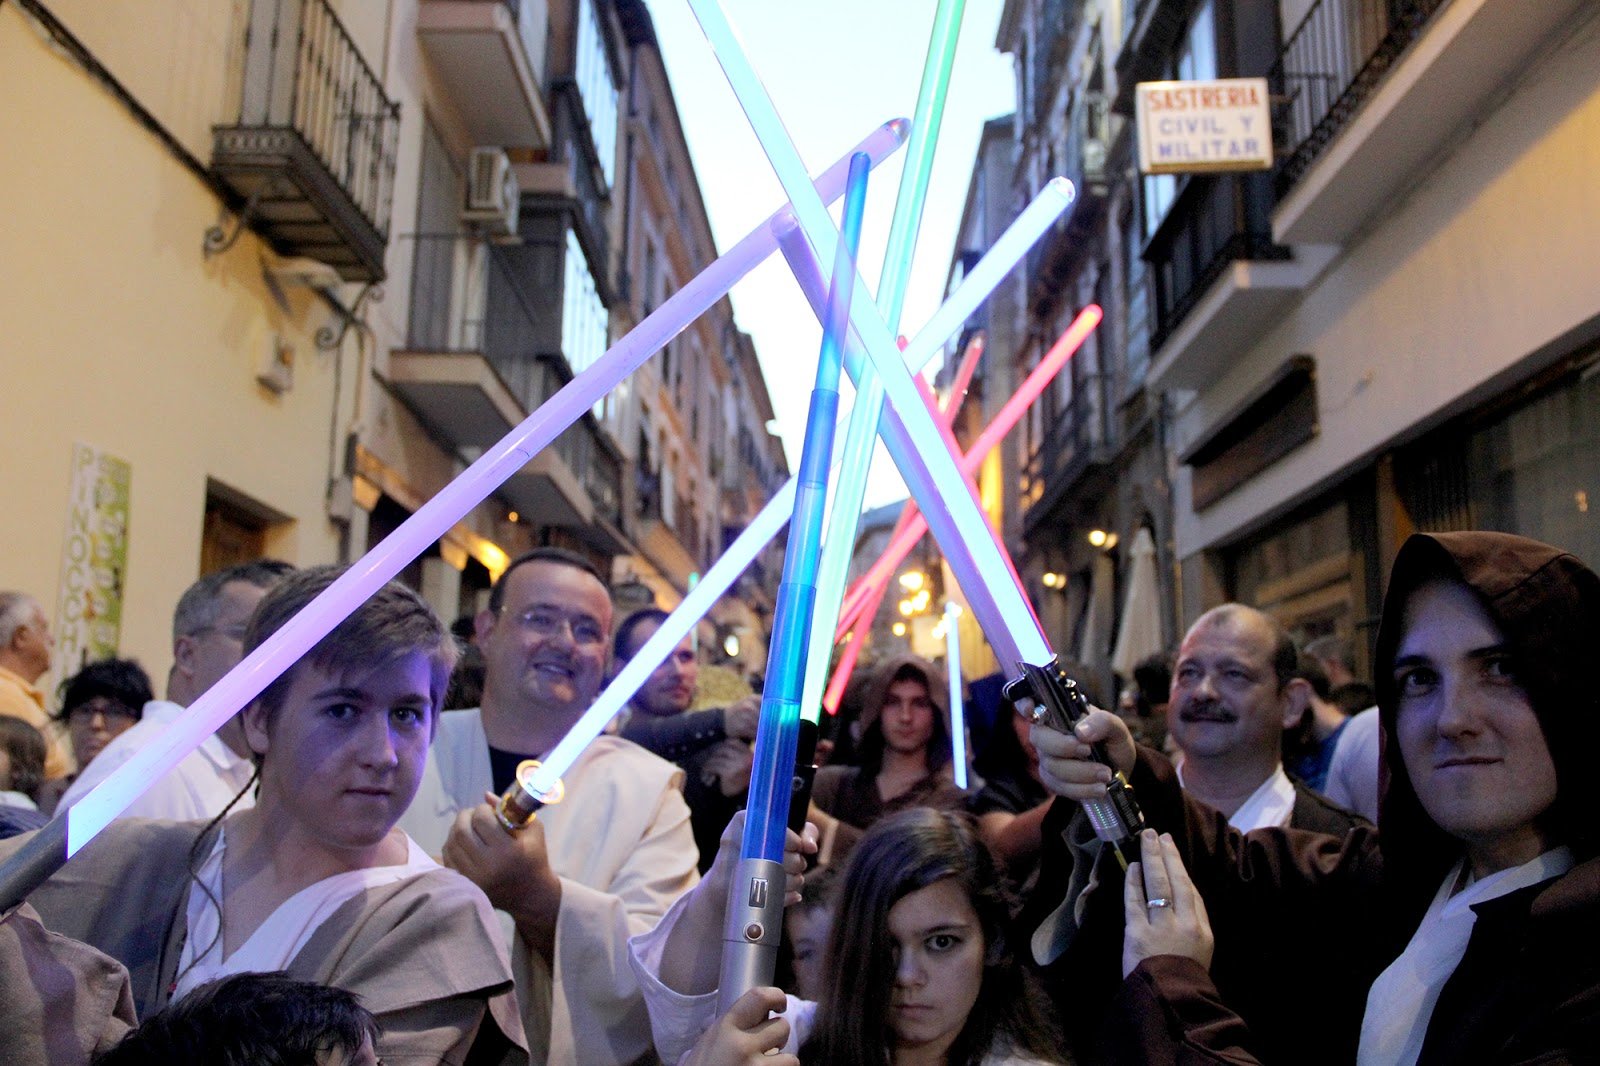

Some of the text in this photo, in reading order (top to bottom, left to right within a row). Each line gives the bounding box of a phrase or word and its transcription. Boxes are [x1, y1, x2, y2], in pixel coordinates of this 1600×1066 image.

[1159, 115, 1254, 135] CIVIL Y
[1158, 138, 1259, 158] MILITAR
[56, 447, 94, 703] PINOCCHI
